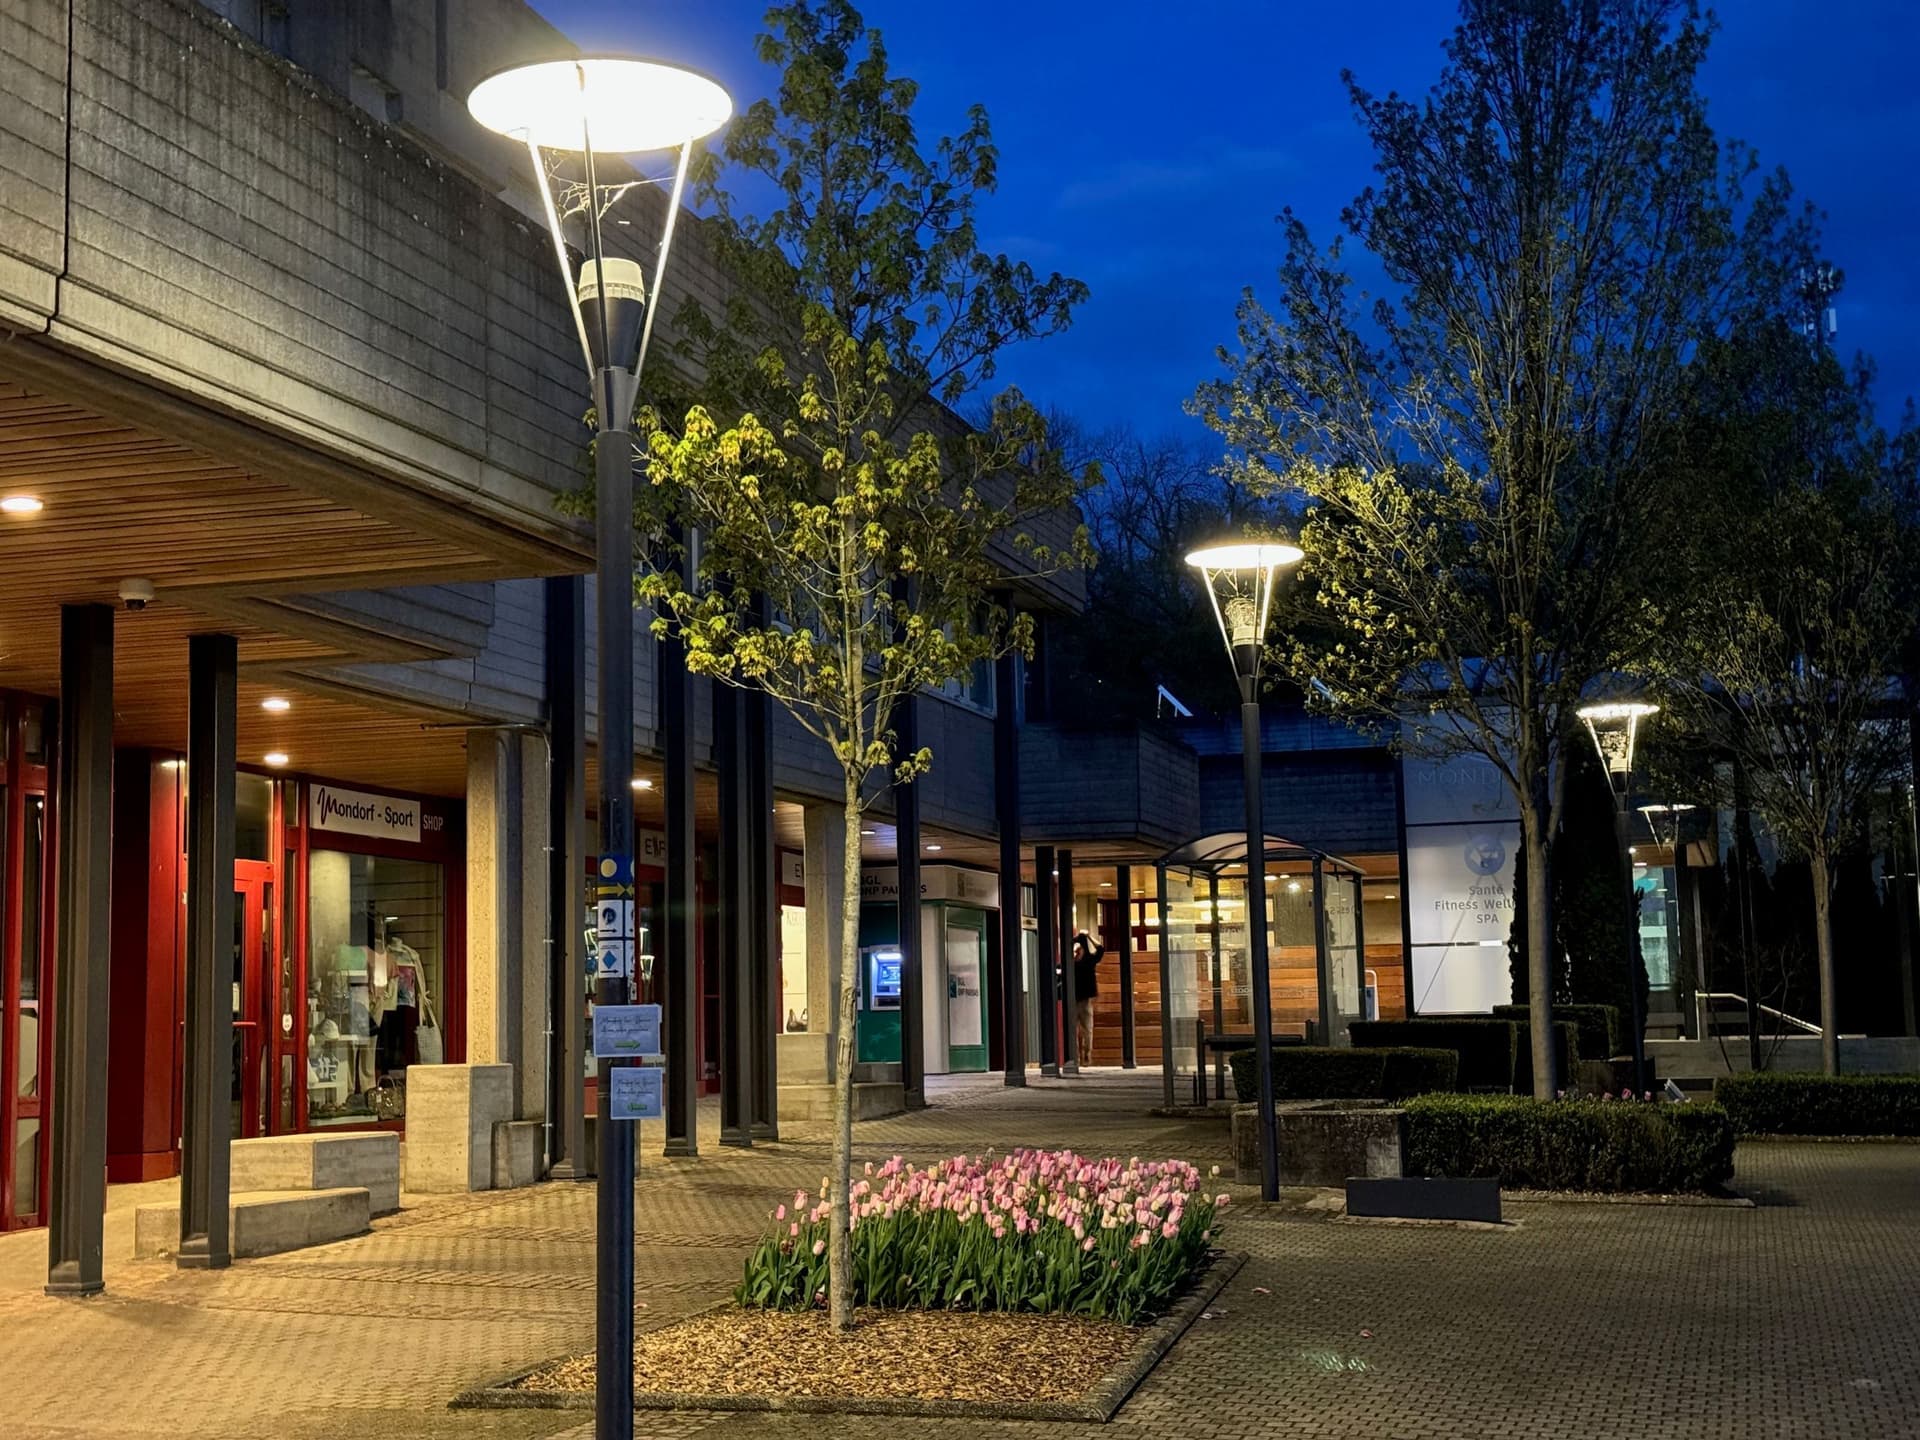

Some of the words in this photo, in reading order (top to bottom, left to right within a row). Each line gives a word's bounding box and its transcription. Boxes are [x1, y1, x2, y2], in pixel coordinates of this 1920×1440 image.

[1418, 767, 1501, 785] MOND
[317, 787, 375, 825] Mondorf
[385, 806, 414, 828] Sport
[423, 814, 444, 832] SHOP
[1435, 900, 1478, 911] Fitness
[1476, 913, 1499, 924] SPA
